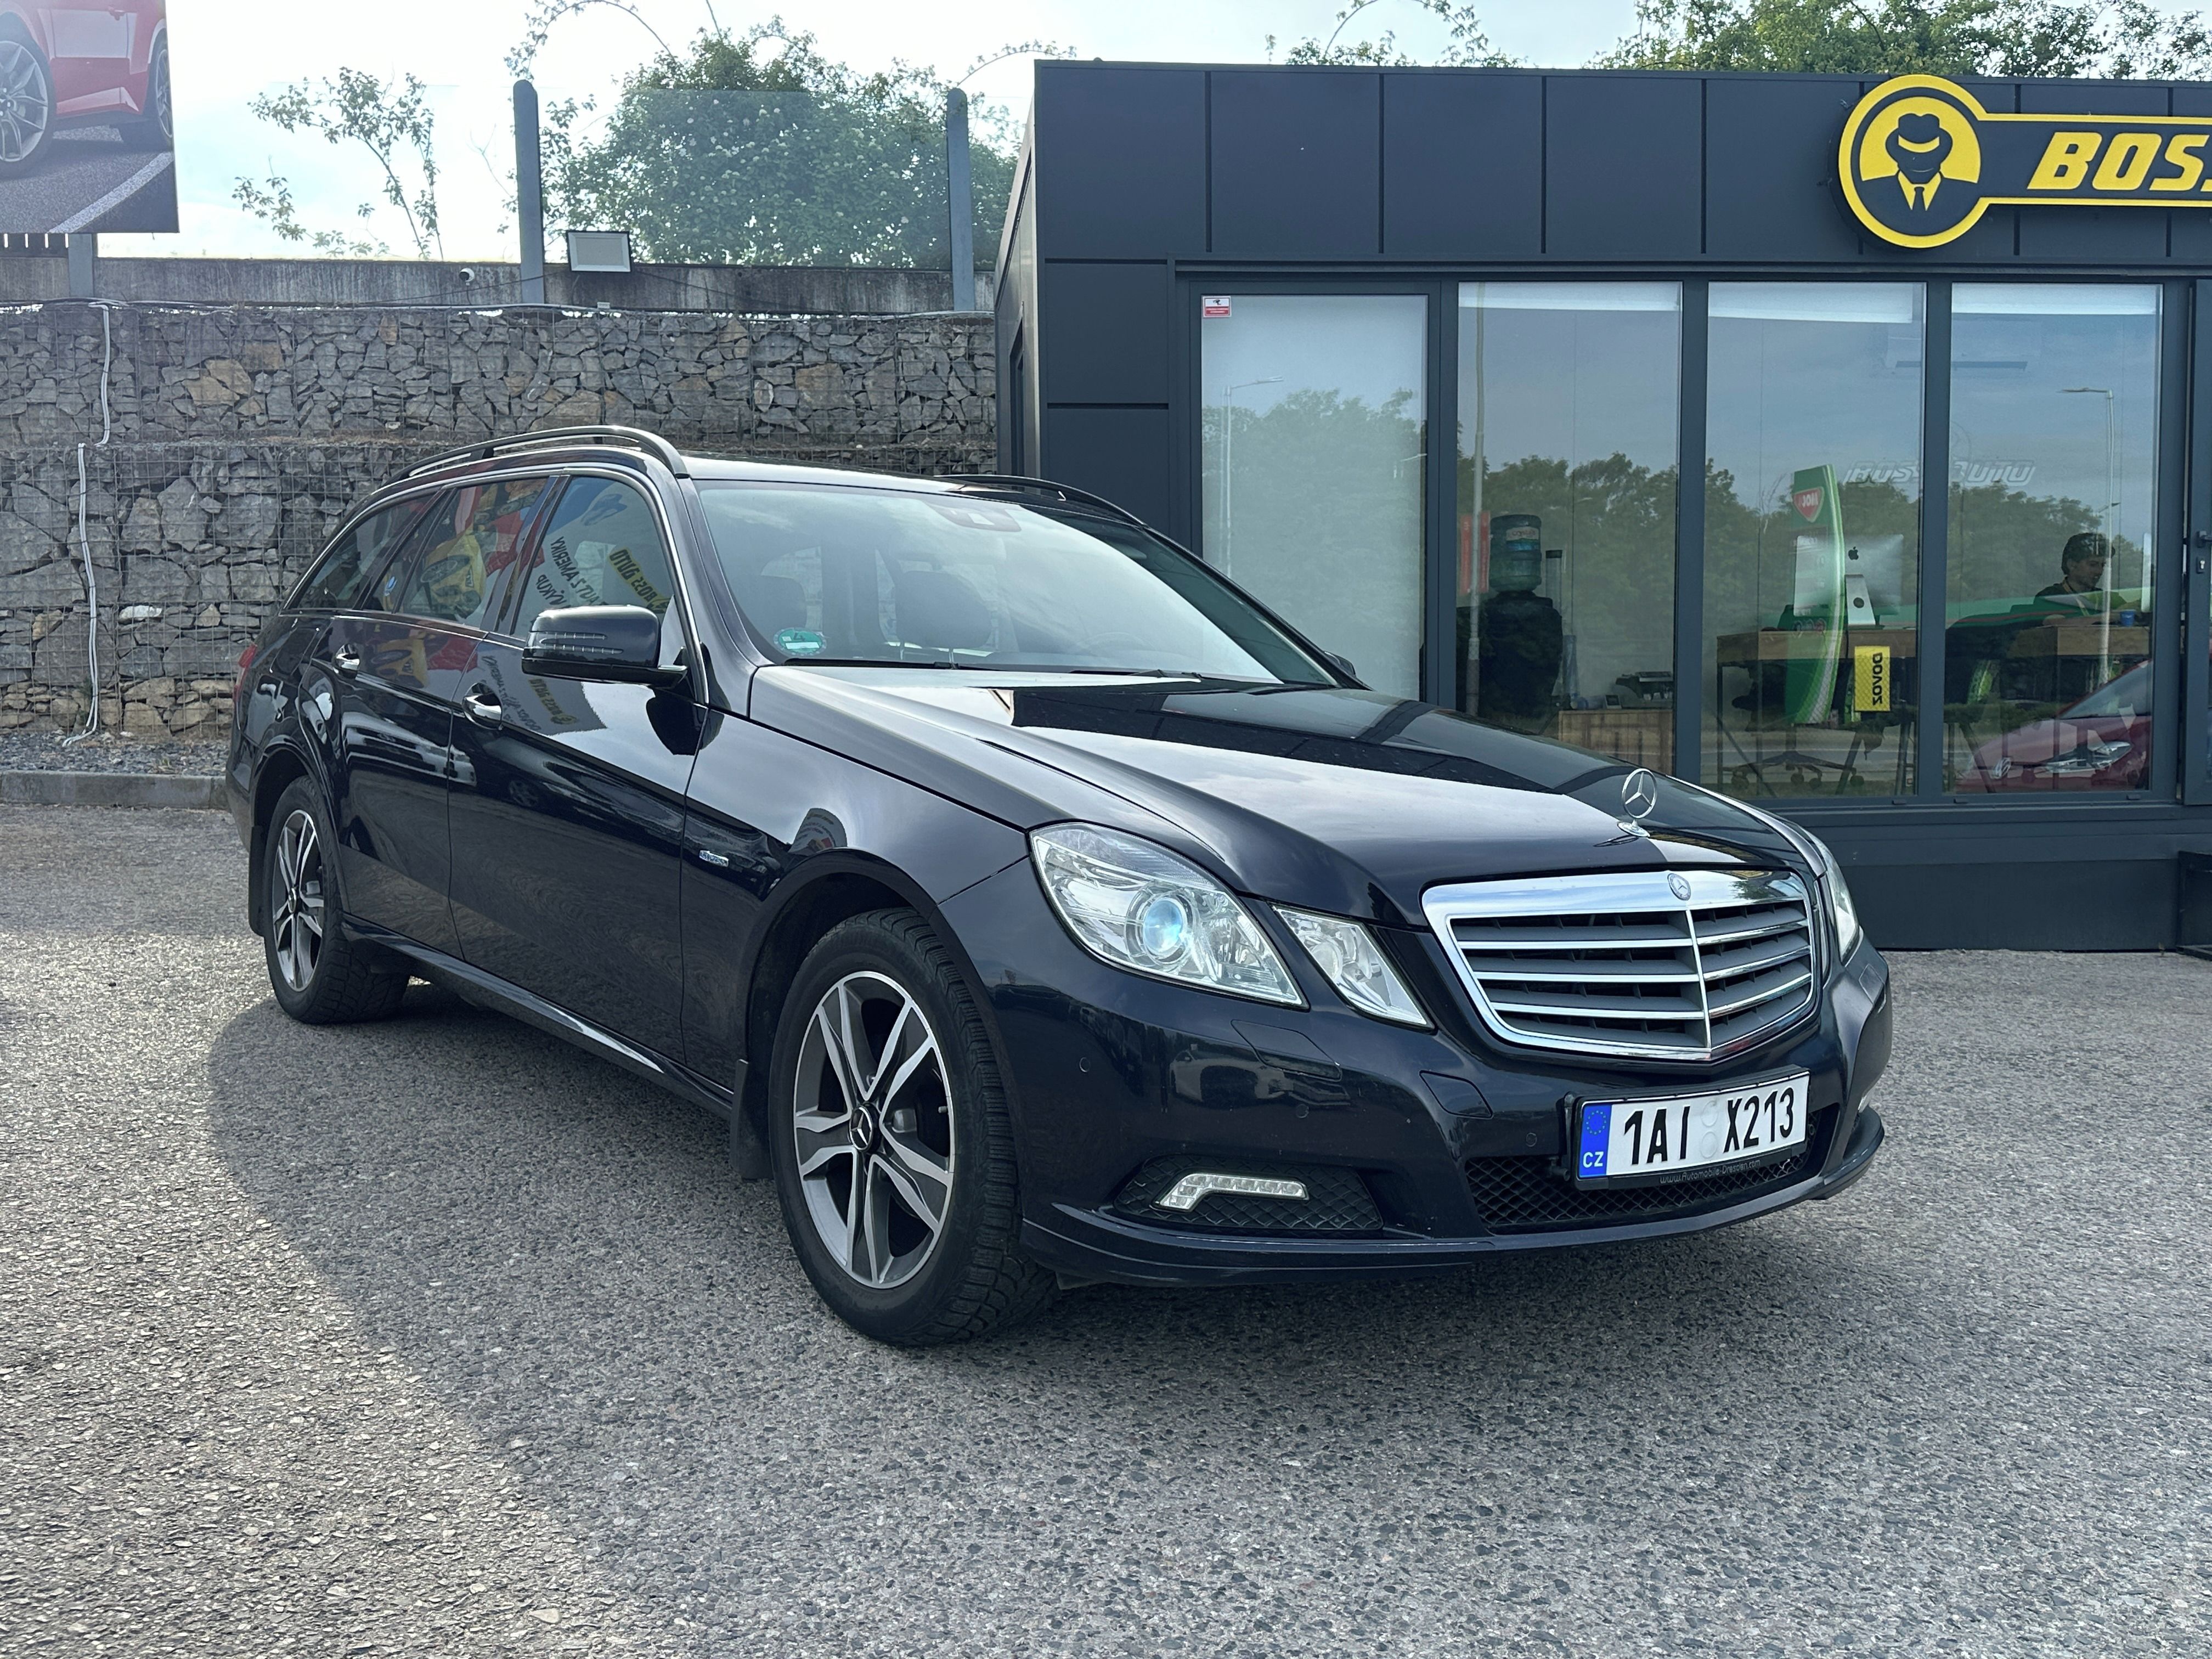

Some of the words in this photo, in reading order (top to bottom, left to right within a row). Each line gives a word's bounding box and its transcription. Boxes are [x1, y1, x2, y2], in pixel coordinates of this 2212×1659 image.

[2027, 132, 2212, 191] BOS
[1843, 460, 1918, 484] BOS
[793, 632, 806, 641] 4
[1723, 1087, 1794, 1153] X213
[1583, 1150, 1604, 1168] CZ
